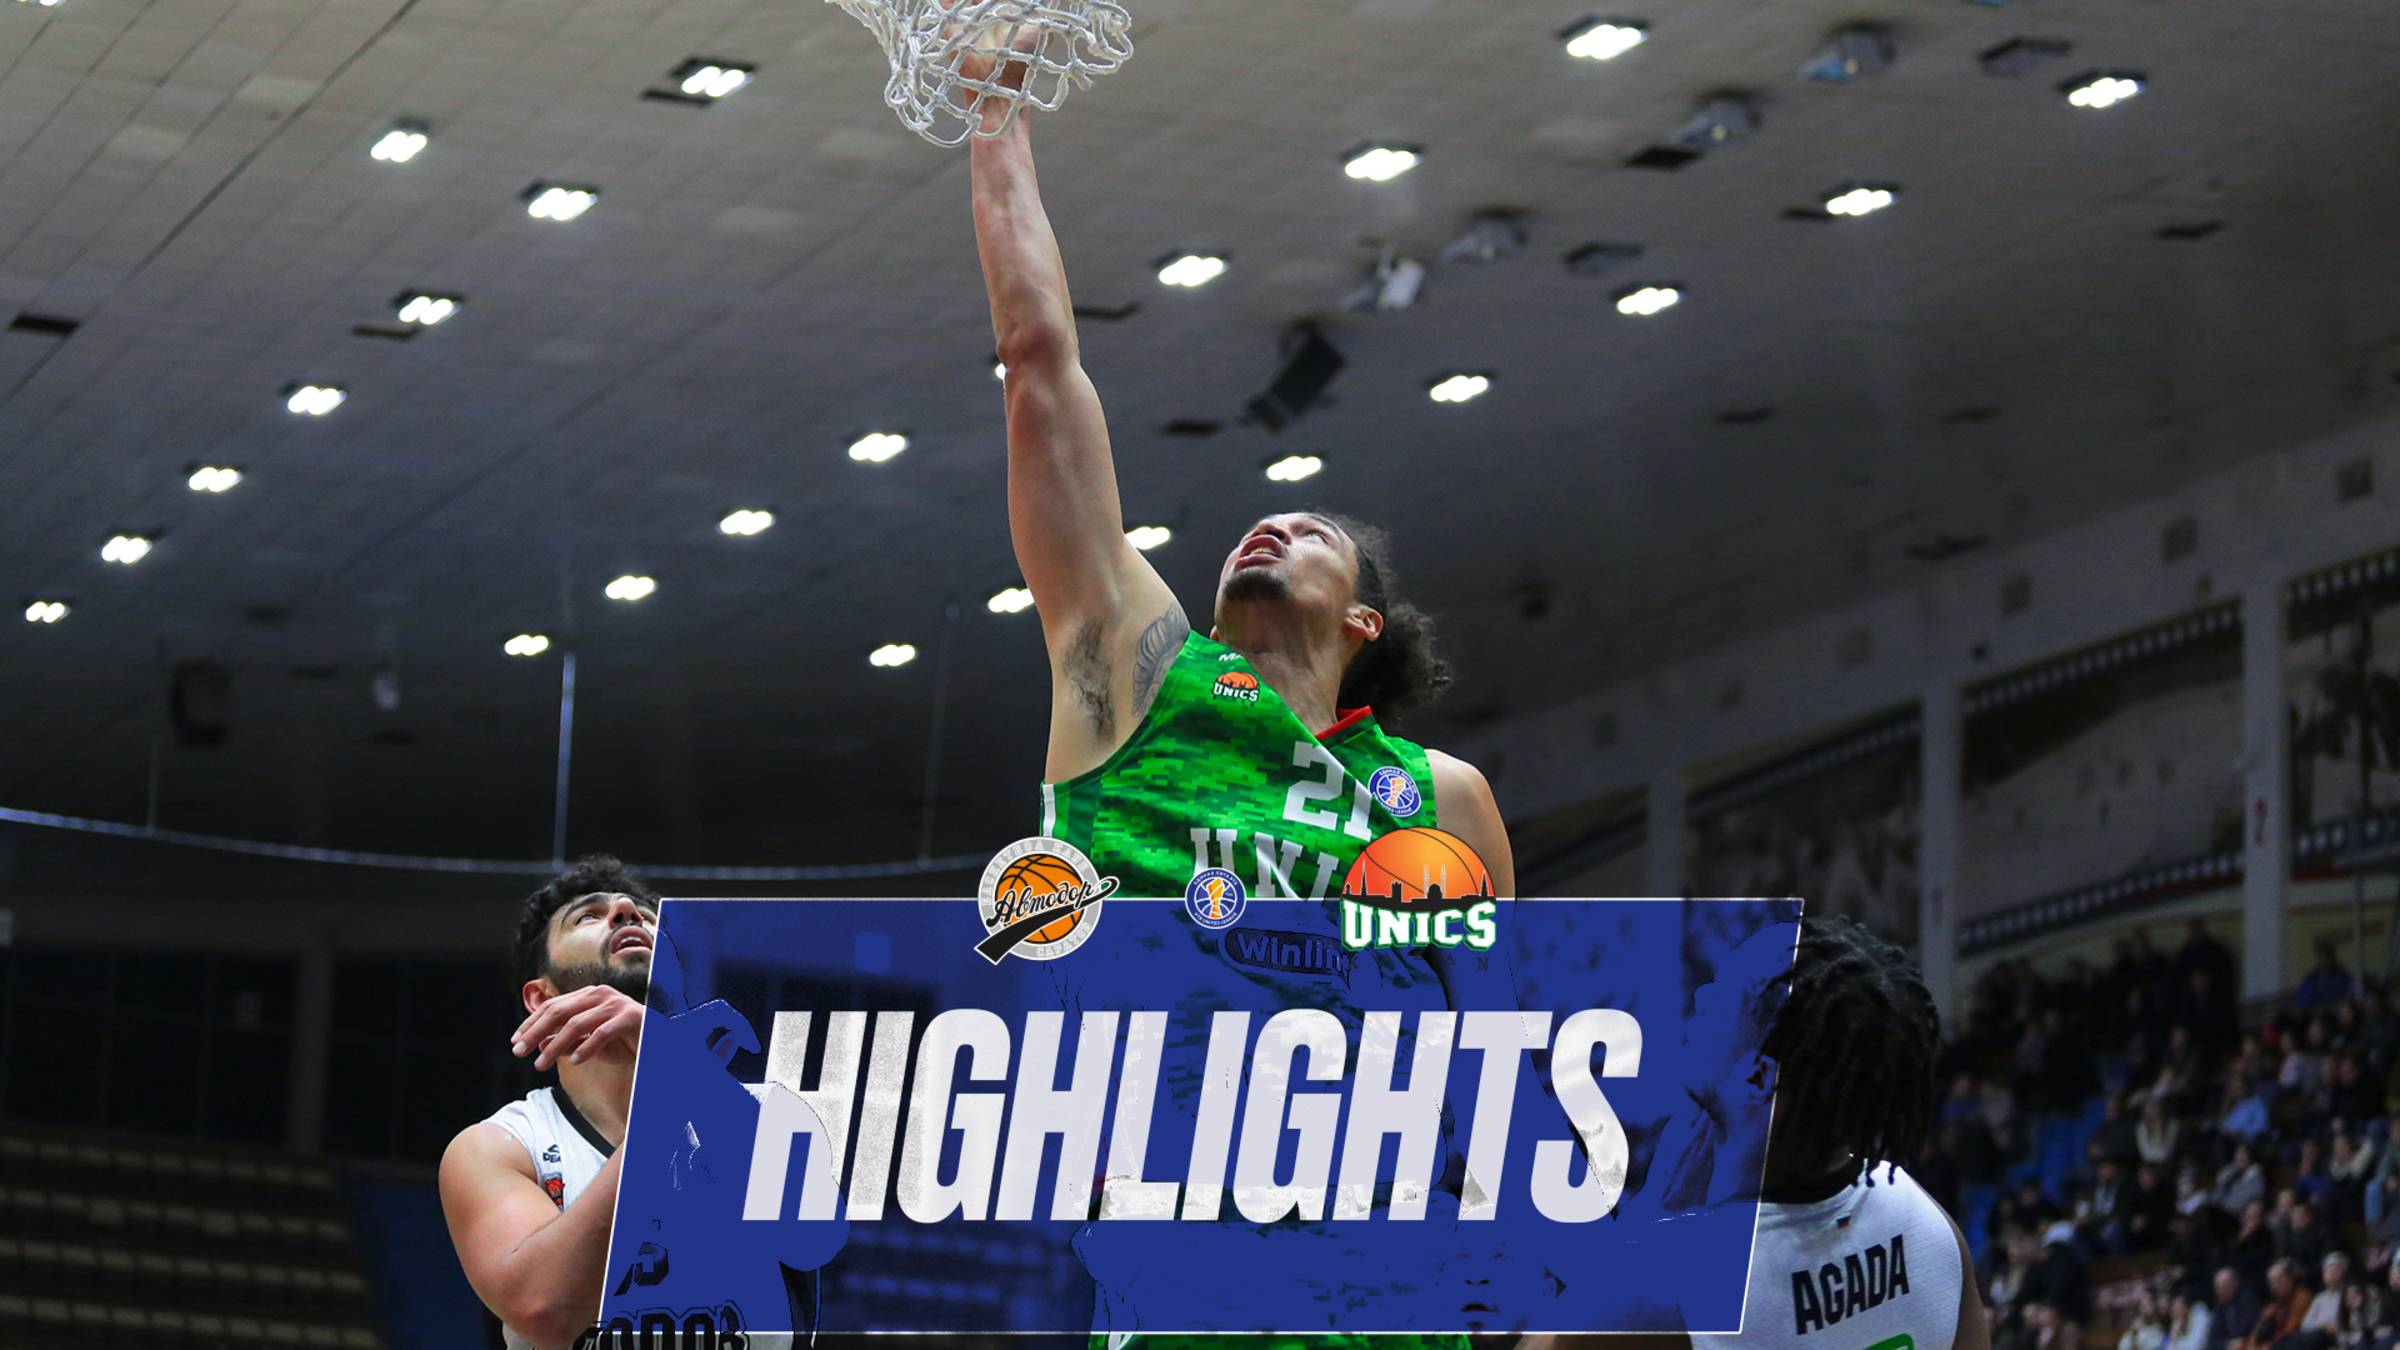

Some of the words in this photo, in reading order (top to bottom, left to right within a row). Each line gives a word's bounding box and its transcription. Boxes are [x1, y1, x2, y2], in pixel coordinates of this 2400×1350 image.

[1212, 681, 1259, 702] UNICS
[1283, 741, 1372, 842] 21
[1791, 1233, 1911, 1336] AGADA
